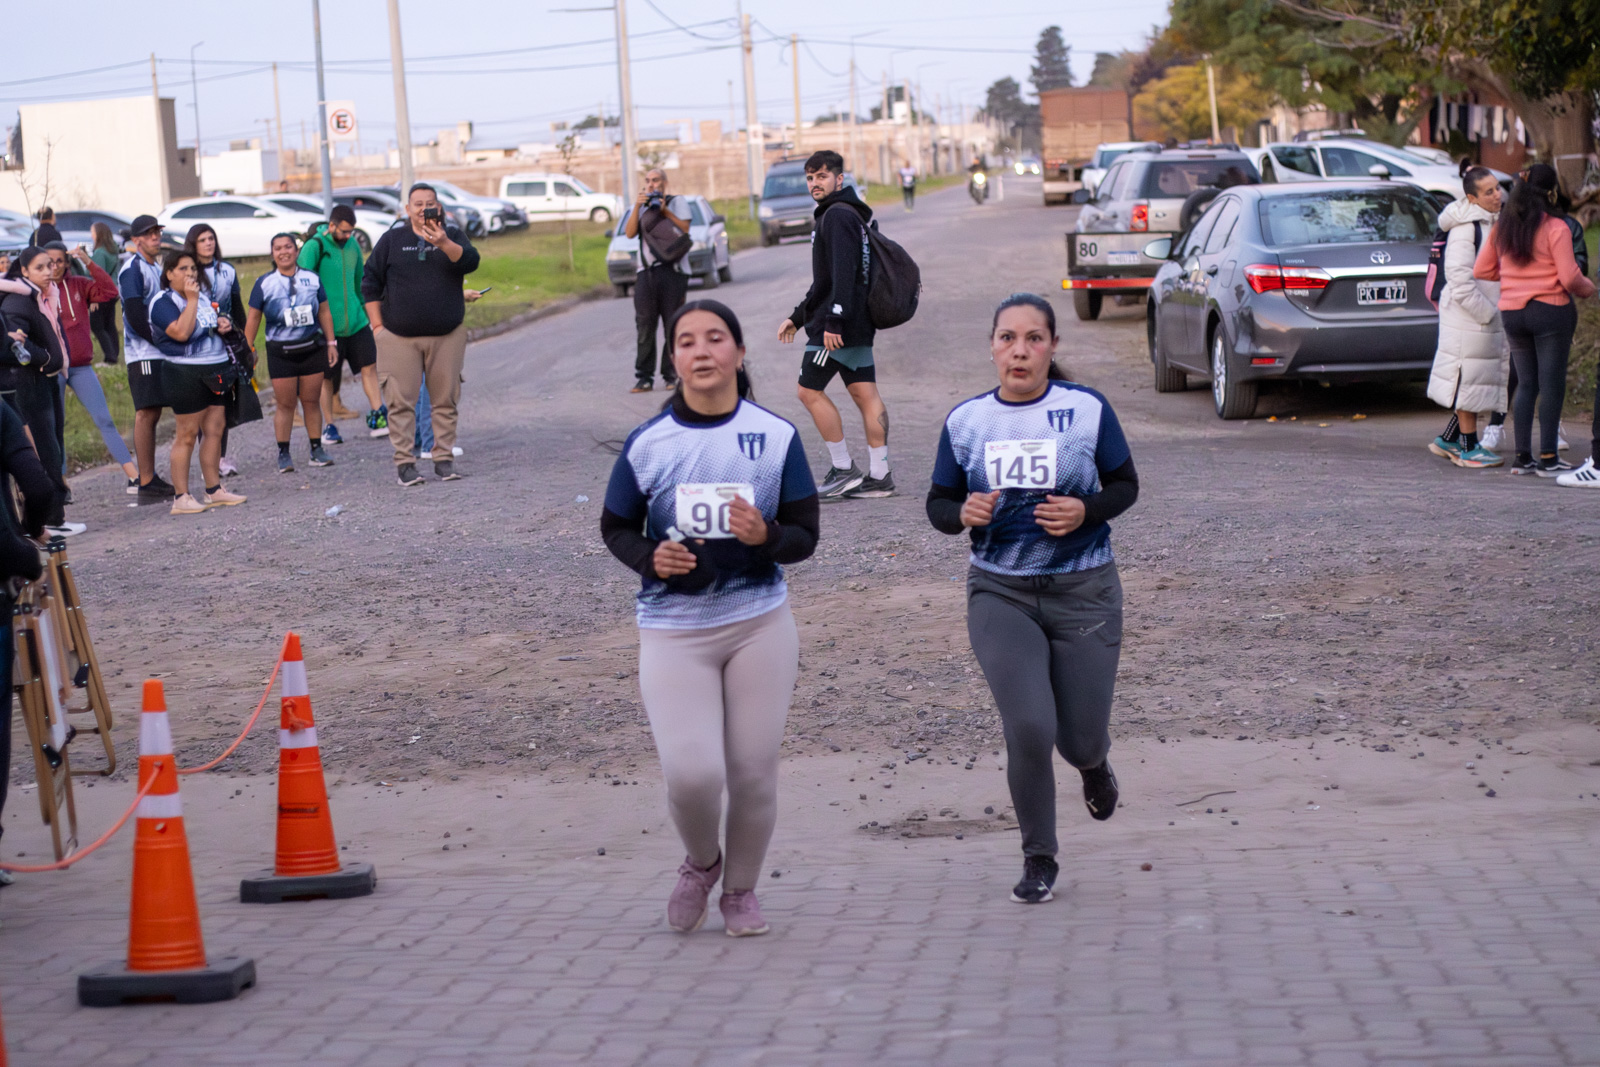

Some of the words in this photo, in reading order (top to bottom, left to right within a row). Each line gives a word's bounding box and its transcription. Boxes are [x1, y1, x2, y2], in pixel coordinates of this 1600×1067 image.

[1080, 242, 1098, 257] 80
[1359, 287, 1380, 301] PKT
[1384, 286, 1405, 300] 477
[742, 433, 762, 442] SFC
[989, 455, 1050, 486] 145
